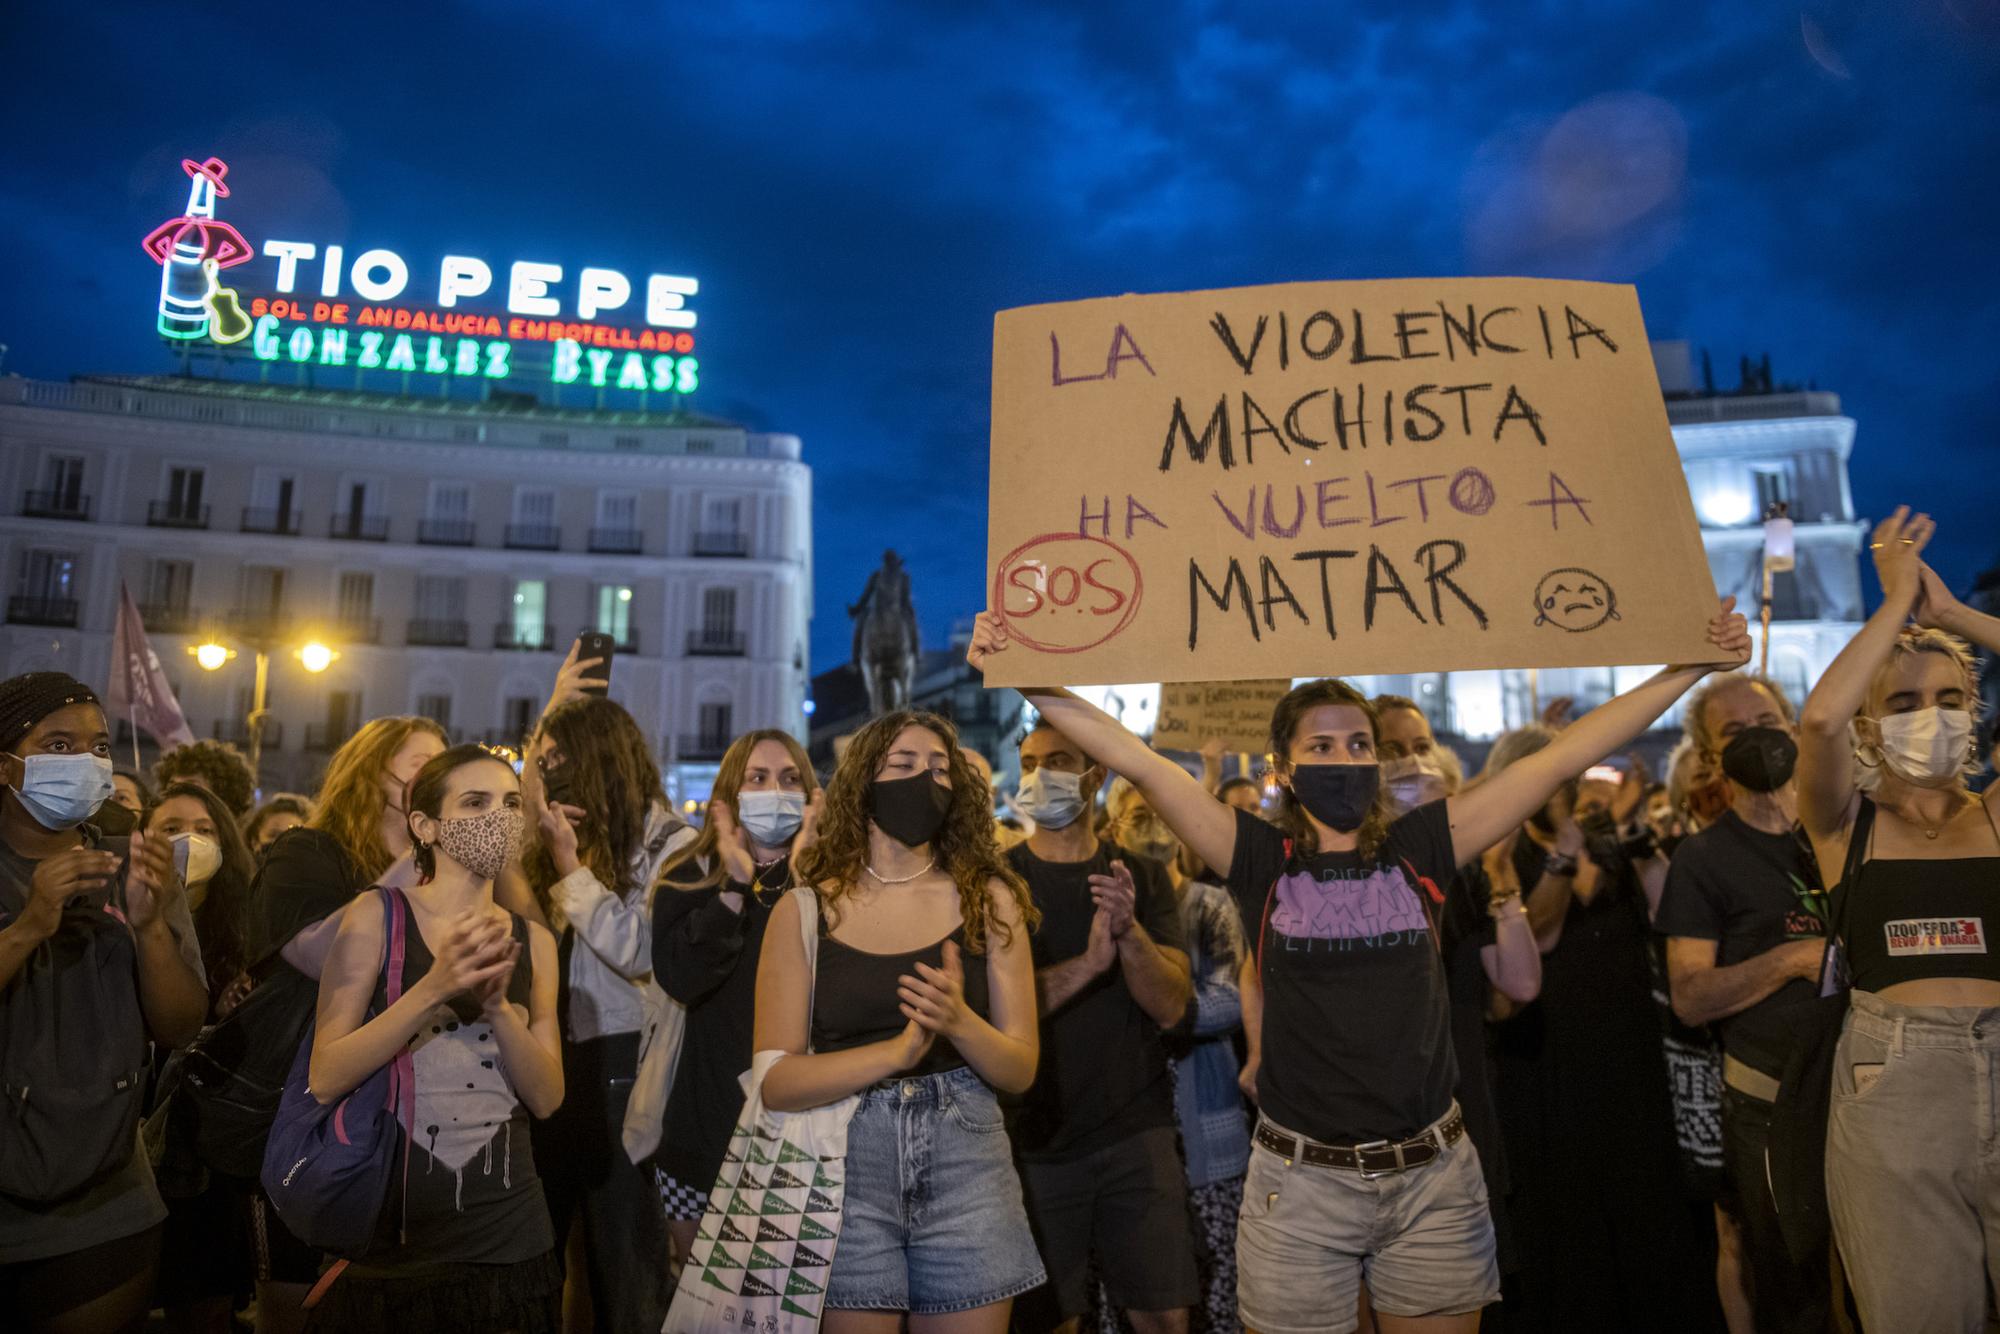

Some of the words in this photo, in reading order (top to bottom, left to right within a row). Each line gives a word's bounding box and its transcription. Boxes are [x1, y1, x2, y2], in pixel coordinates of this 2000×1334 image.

[251, 298, 307, 321] SOL
[312, 302, 349, 325] DE
[356, 306, 502, 336] ANDALUCIA
[507, 317, 695, 354] EMBOTELLADO
[263, 240, 409, 301] TIO
[438, 255, 699, 328] PEPE
[253, 313, 511, 379] GONZALEZ
[551, 337, 699, 394] BYASS
[1052, 323, 1156, 387] LA
[1209, 302, 1618, 376] VIOLENCIA
[1158, 383, 1547, 472] MACHISTA
[1079, 494, 1168, 540] HA
[1212, 466, 1496, 540] VUELTO
[1527, 471, 1593, 530] A
[1188, 539, 1490, 652] MATAR
